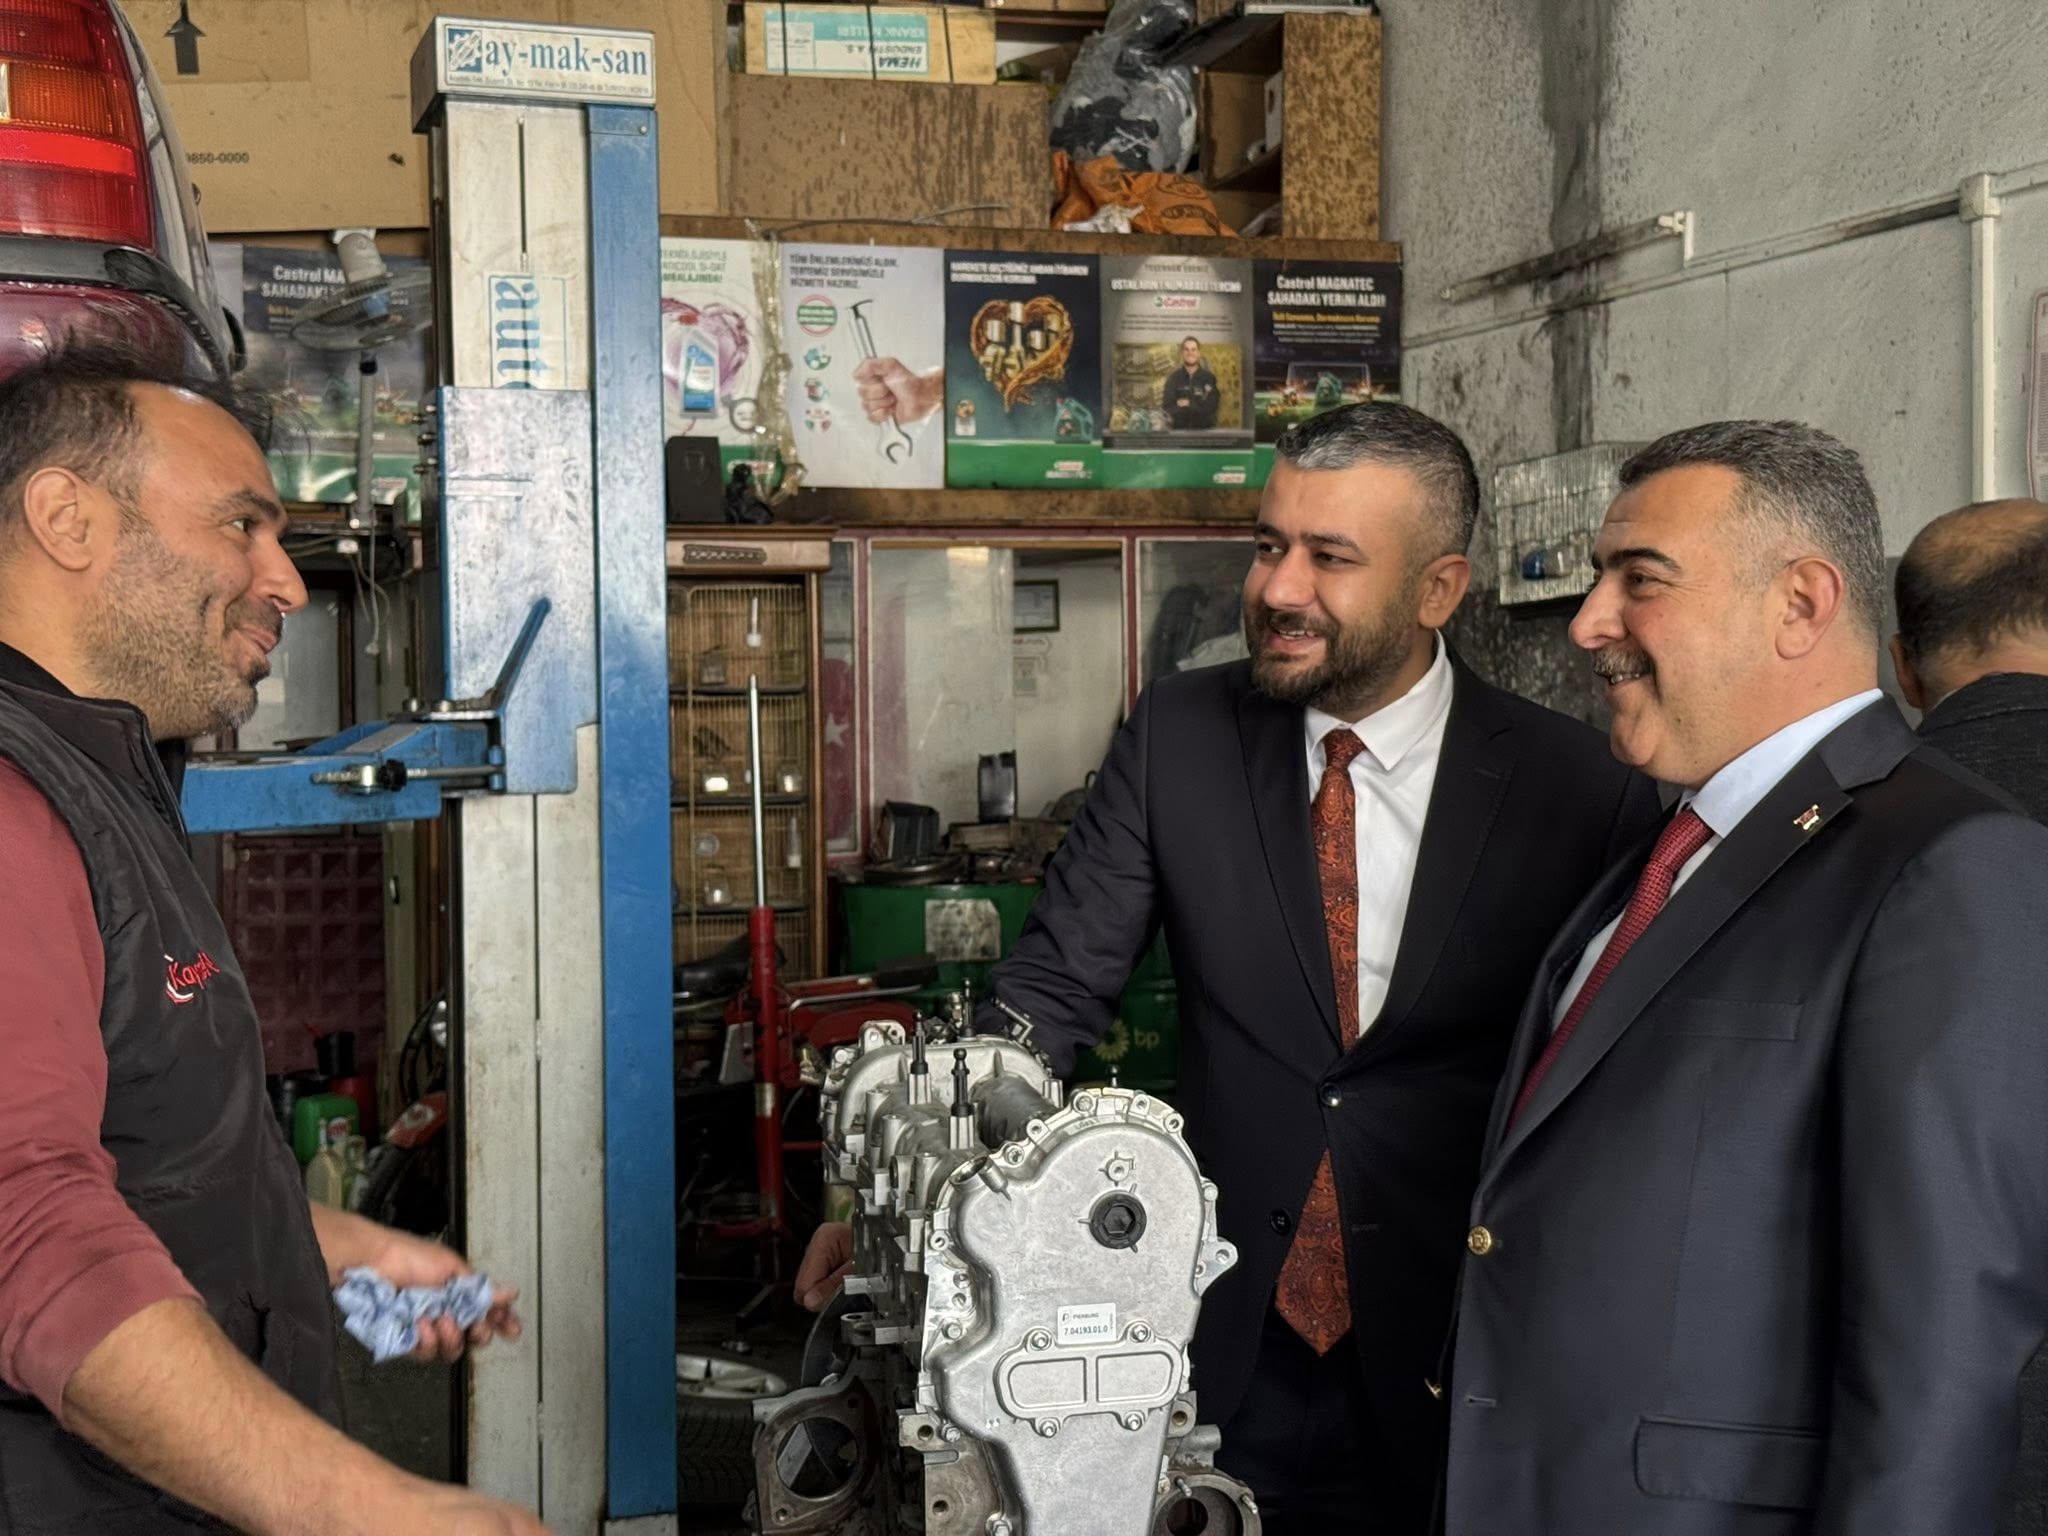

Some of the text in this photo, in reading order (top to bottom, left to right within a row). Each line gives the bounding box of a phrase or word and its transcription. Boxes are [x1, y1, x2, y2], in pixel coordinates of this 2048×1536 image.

[486, 38, 648, 76] ay-mak-san
[879, 57, 922, 69] HEMA
[272, 264, 322, 283] Castrol
[1276, 274, 1375, 291] Castrol MAGNATEC
[1163, 297, 1197, 308] Castrol
[495, 282, 549, 389] aut
[1133, 1026, 1159, 1051] bp
